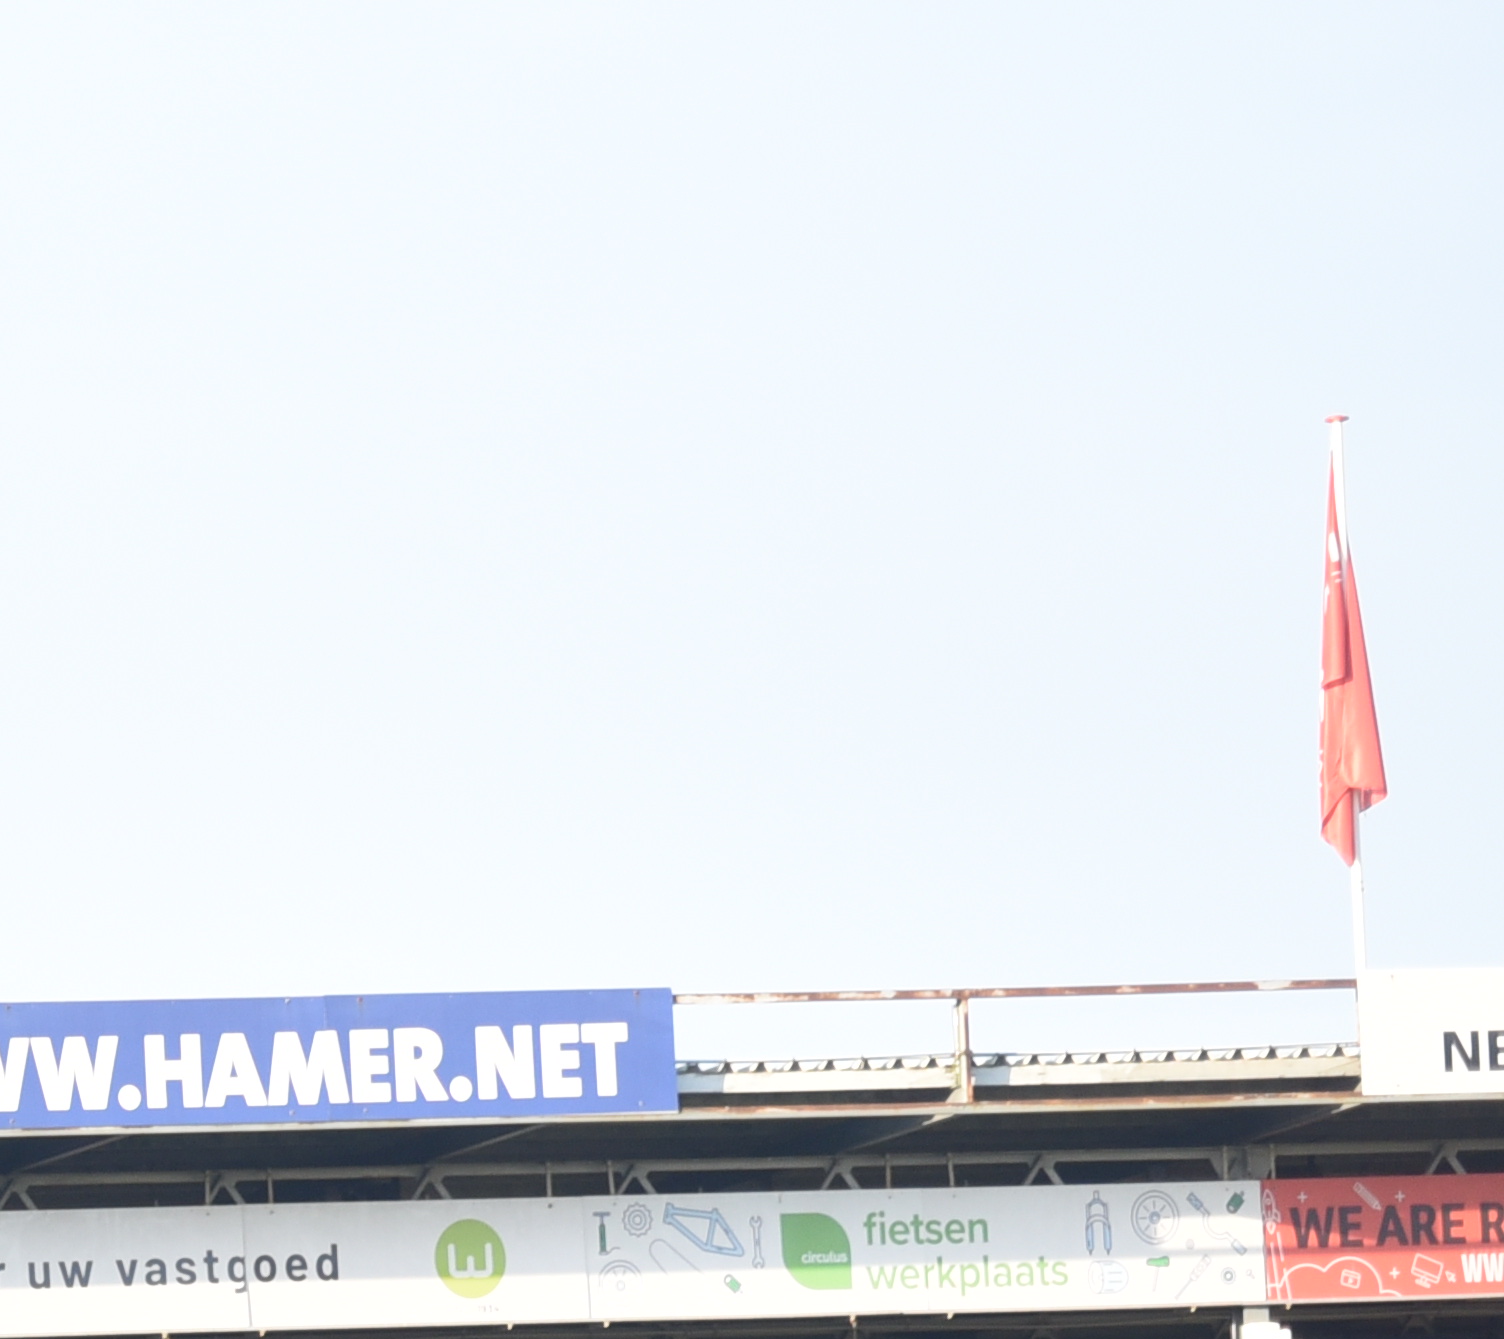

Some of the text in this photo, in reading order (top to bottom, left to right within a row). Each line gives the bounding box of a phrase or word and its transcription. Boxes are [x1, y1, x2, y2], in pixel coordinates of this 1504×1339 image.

[863, 1210, 990, 1246] fietsen
[1290, 1205, 1365, 1249] WE
[1375, 1203, 1465, 1247] ARE
[26, 1255, 94, 1290] uw
[116, 1244, 341, 1294] vastgoed
[801, 1251, 849, 1265] circulus
[865, 1254, 1070, 1298] werkplaats
